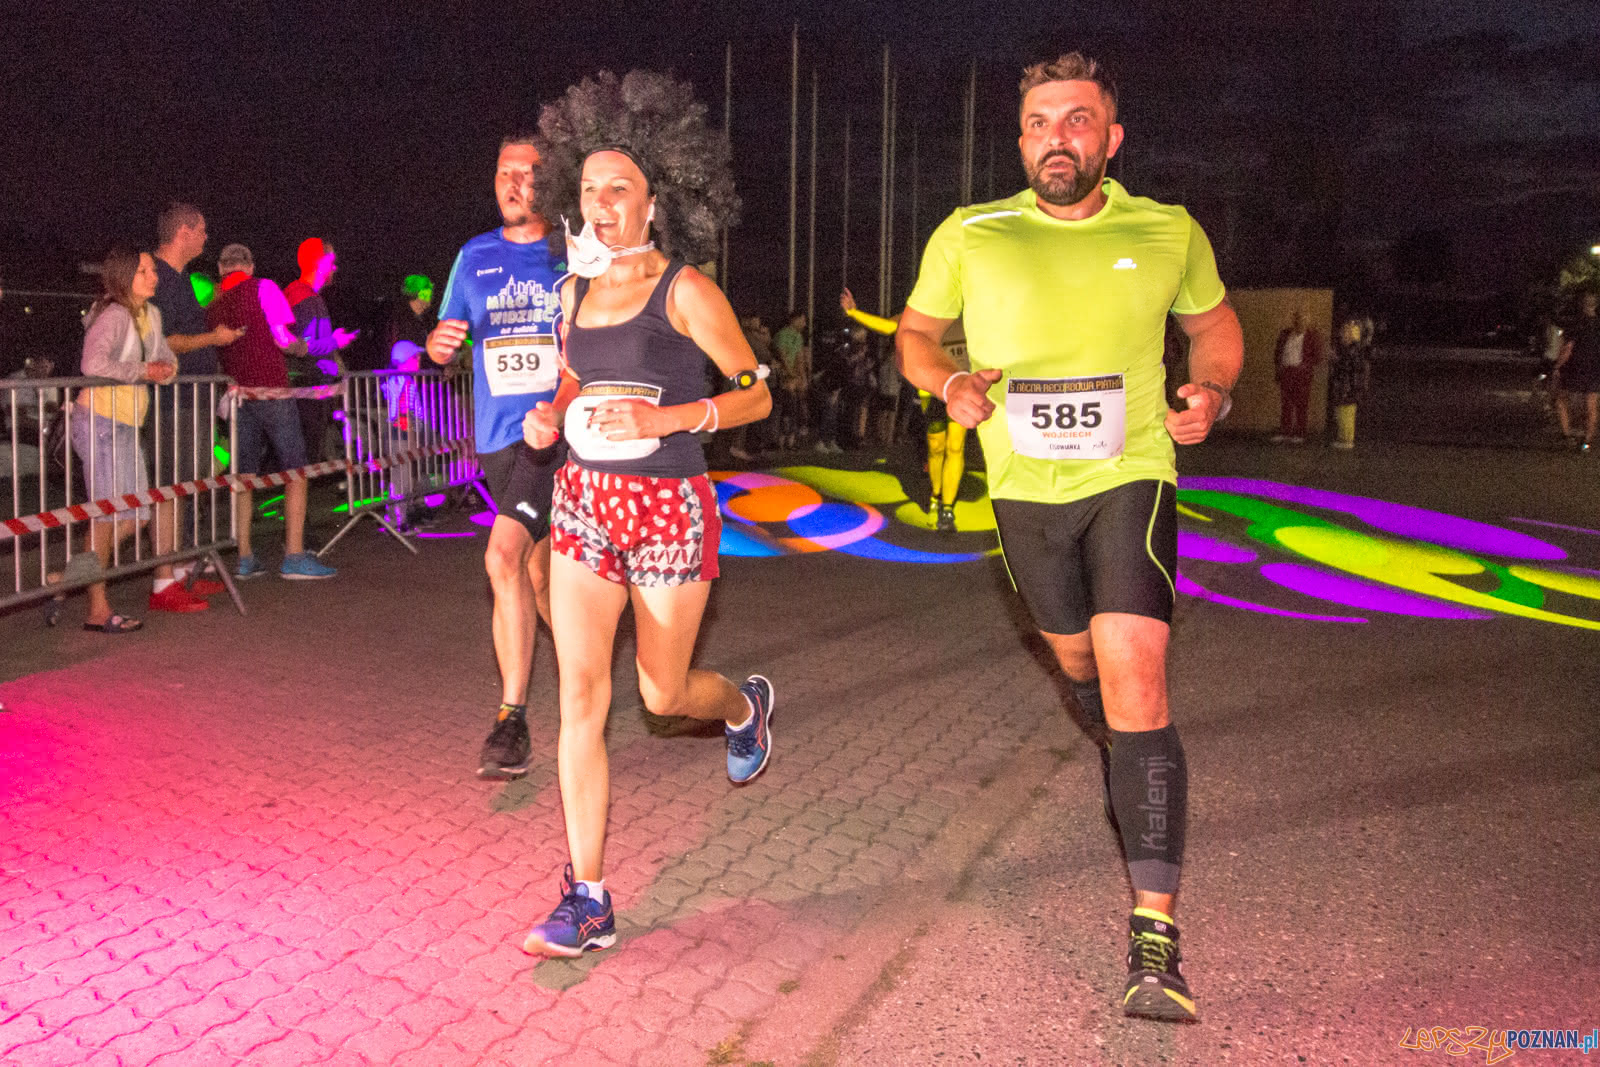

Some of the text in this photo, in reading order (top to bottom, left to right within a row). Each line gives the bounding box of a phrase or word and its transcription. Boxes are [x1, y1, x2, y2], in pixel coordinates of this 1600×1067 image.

[486, 293, 529, 311] MIŁO
[497, 352, 541, 373] 539
[1031, 402, 1103, 429] 585
[1042, 431, 1092, 439] WOJCIECH
[1137, 755, 1178, 851] Kalenji
